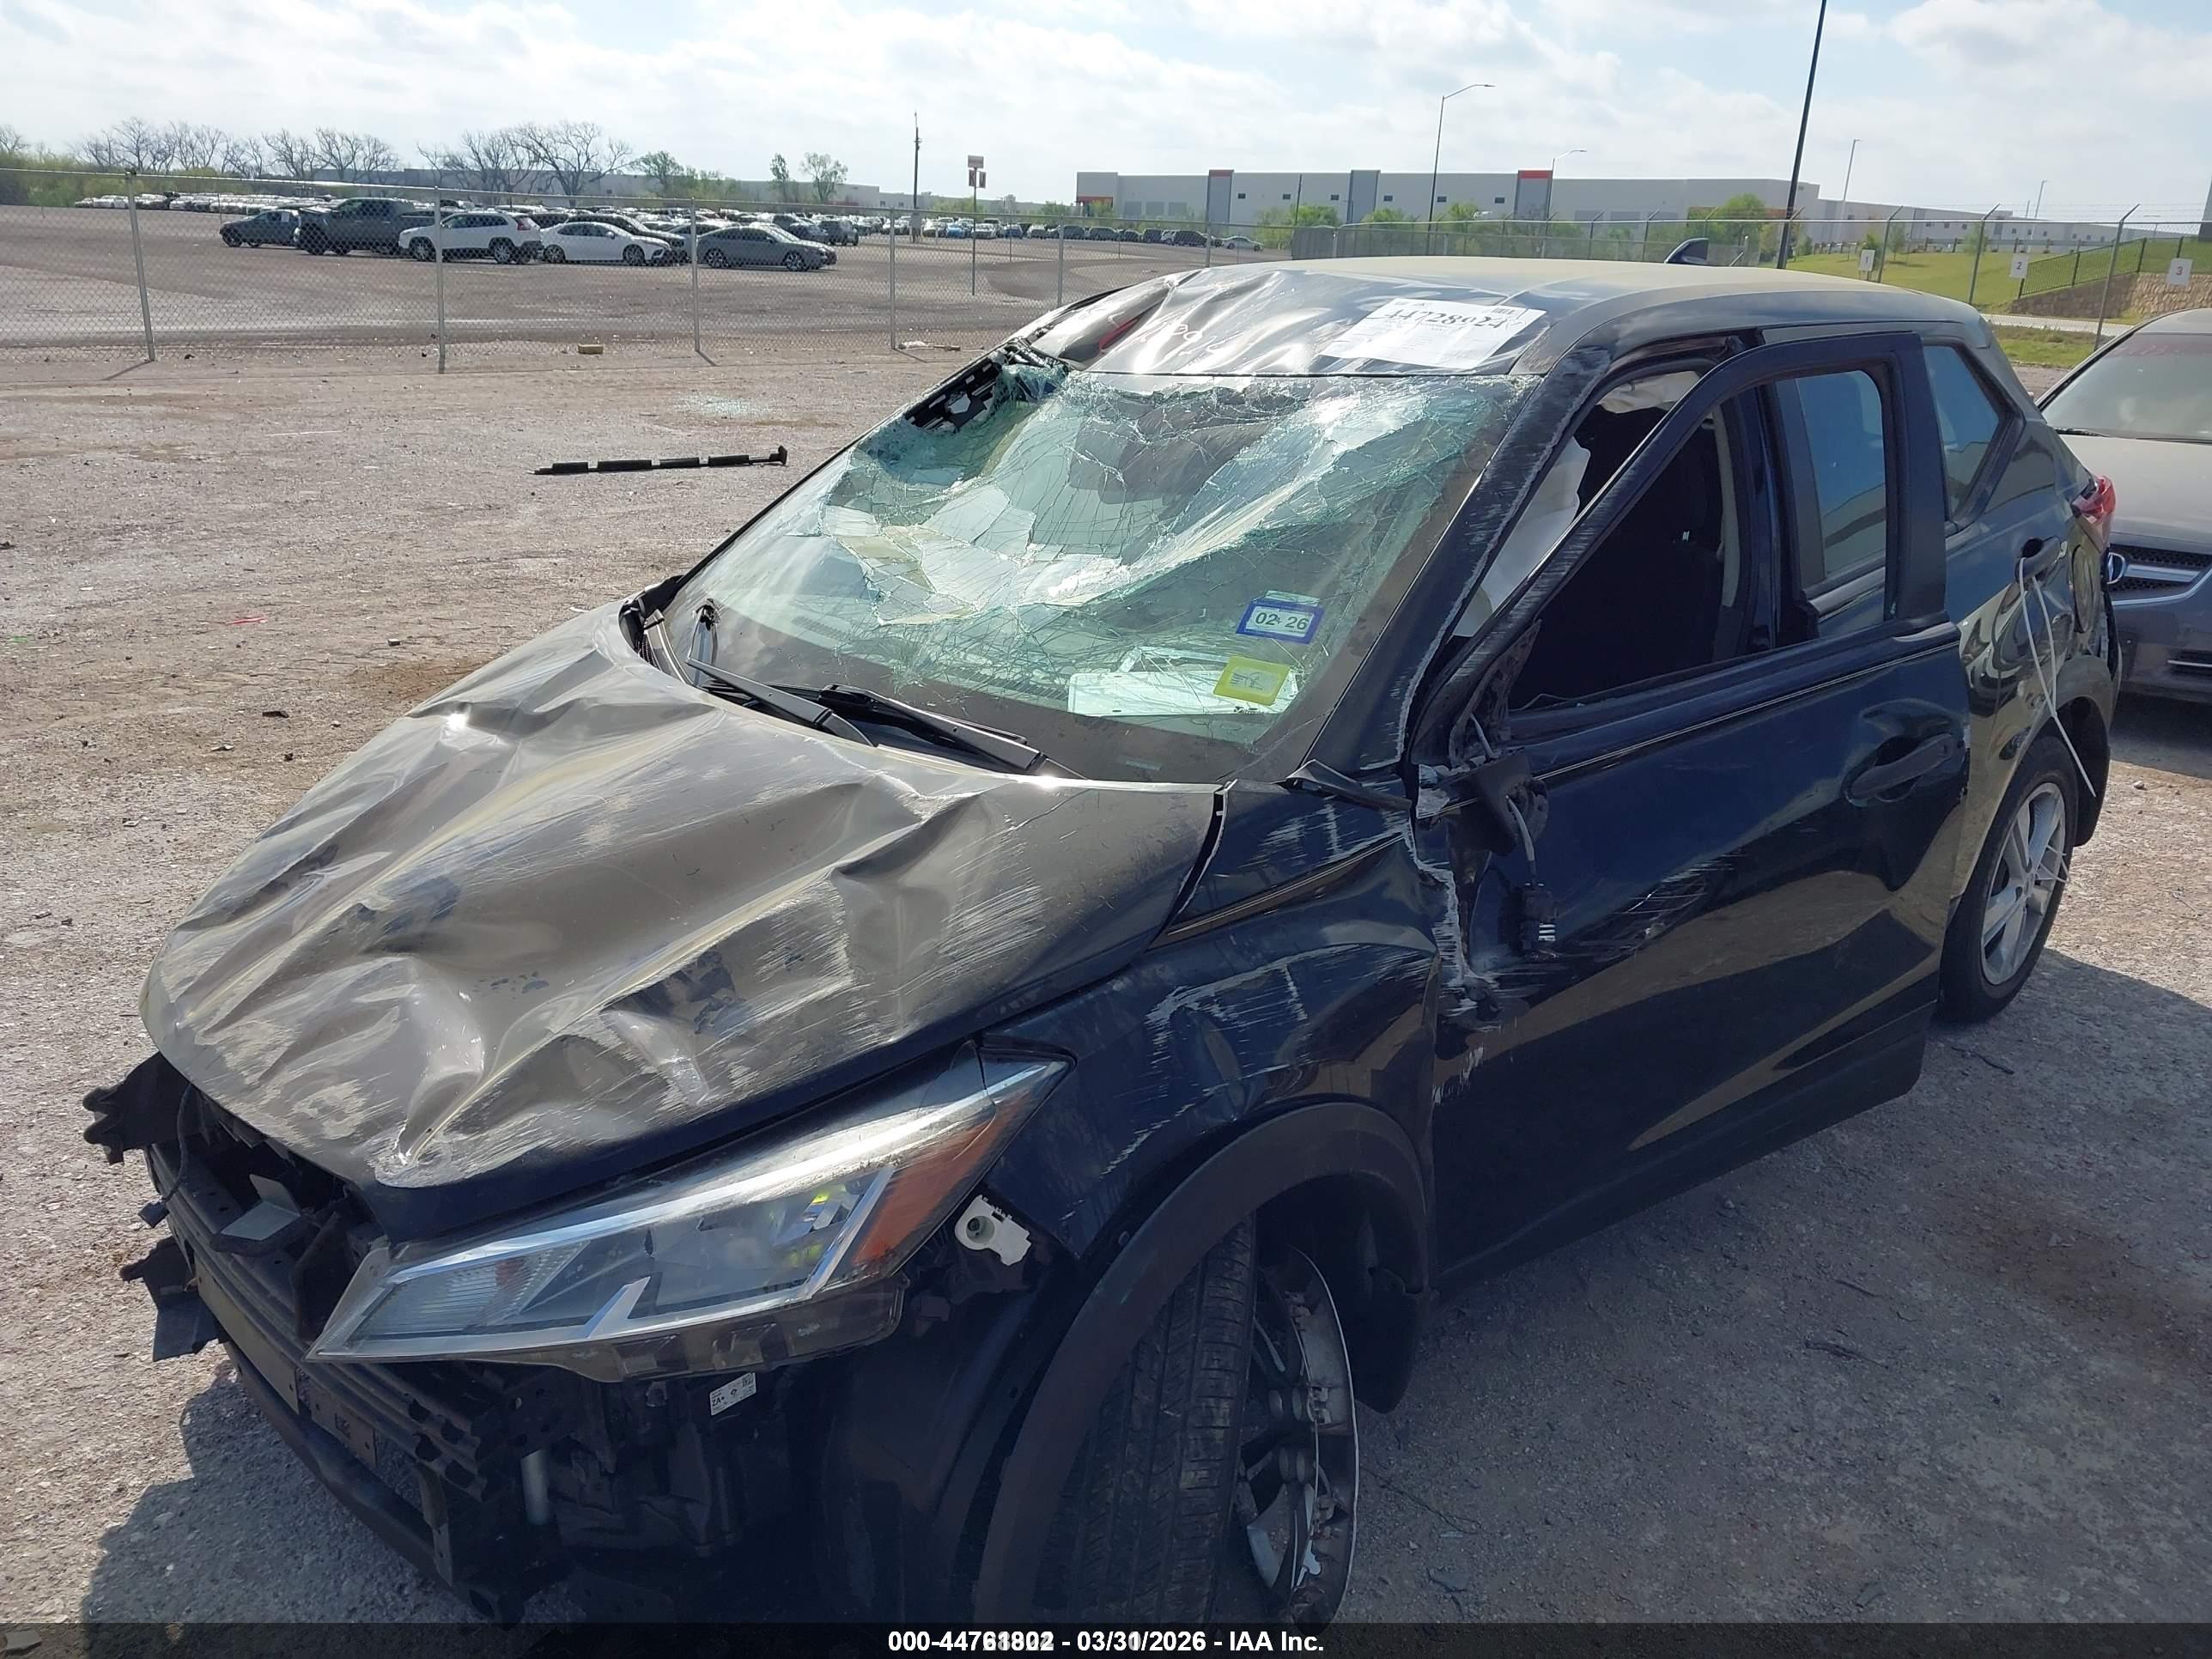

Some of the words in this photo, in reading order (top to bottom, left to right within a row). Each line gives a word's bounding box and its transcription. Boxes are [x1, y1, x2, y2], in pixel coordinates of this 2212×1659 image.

[2016, 261, 2023, 270] 2
[2175, 266, 2184, 276] 3
[1255, 612, 1279, 626] 02
[1285, 616, 1310, 630] 26
